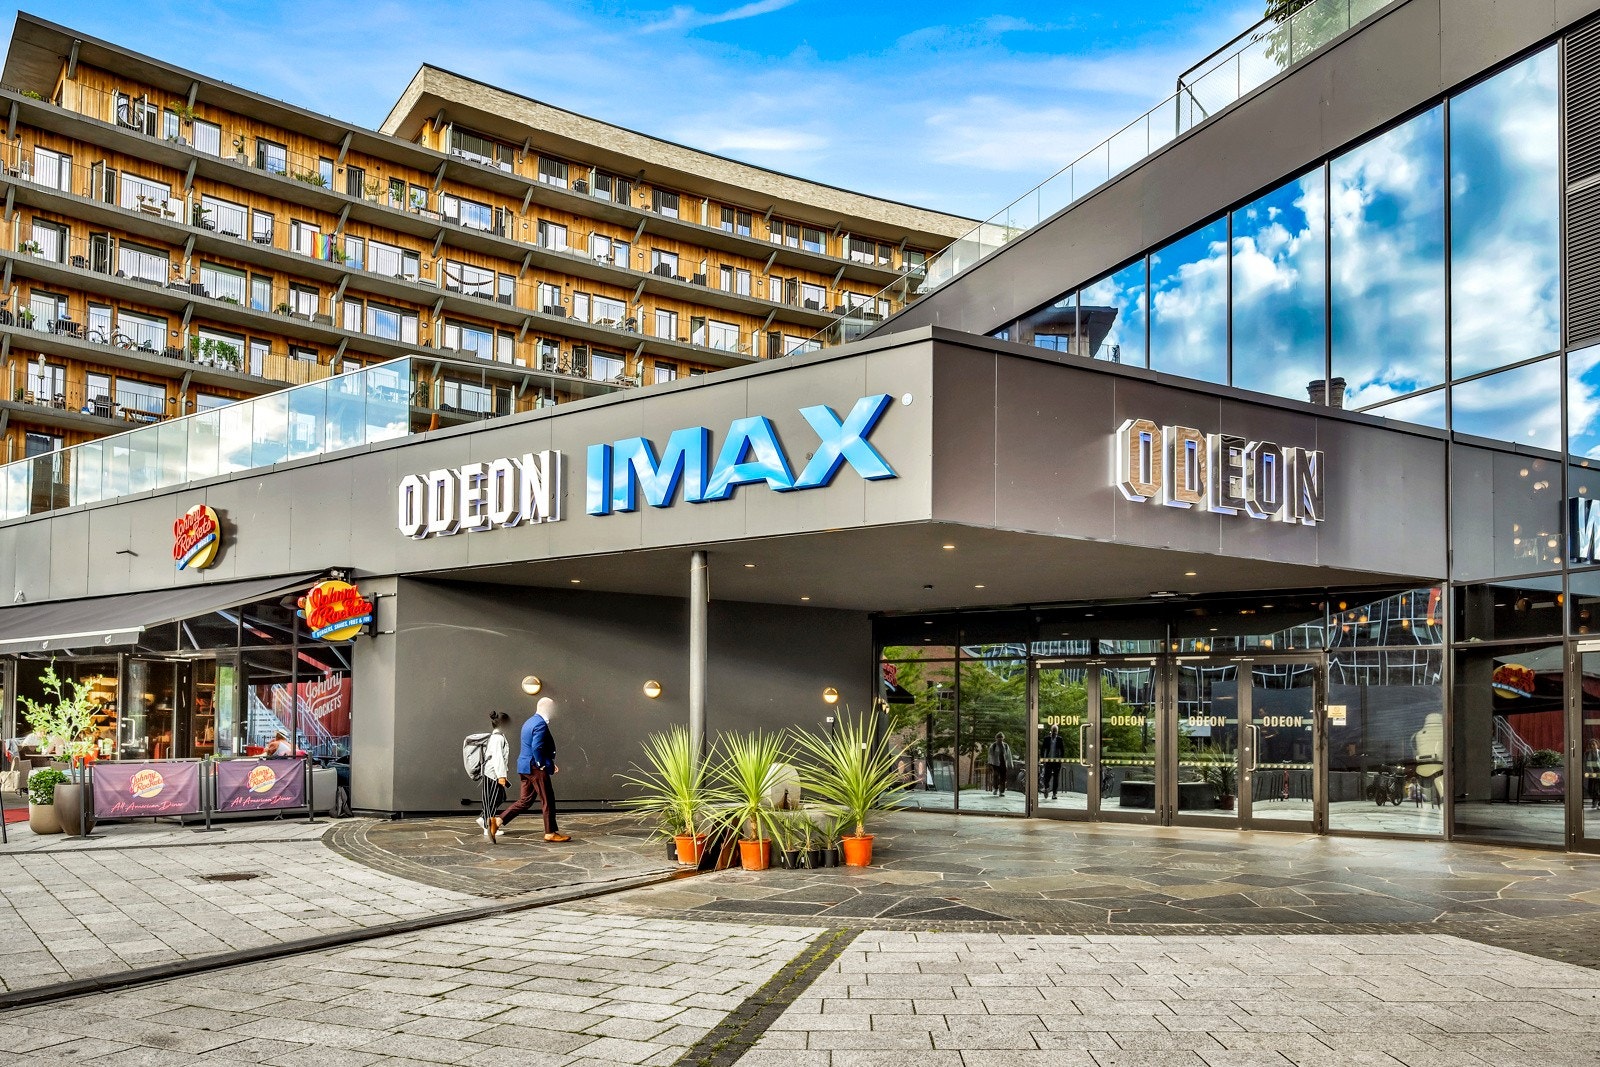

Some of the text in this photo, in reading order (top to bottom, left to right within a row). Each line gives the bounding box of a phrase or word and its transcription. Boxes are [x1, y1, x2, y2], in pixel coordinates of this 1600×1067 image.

[399, 393, 898, 539] ODEON IMAX
[1116, 418, 1325, 526] ODEON
[173, 504, 206, 543] Johnny
[172, 517, 214, 560] Rockets
[310, 585, 358, 610] Johnny
[307, 600, 373, 628] Rockets
[305, 671, 342, 712] Johnny
[314, 696, 342, 720] ROCKETS
[1047, 715, 1080, 726] ODEON
[1110, 715, 1145, 726] ODEON
[1188, 716, 1226, 727] ODEON
[1263, 715, 1302, 728] ODEON
[130, 772, 157, 786] Johnny
